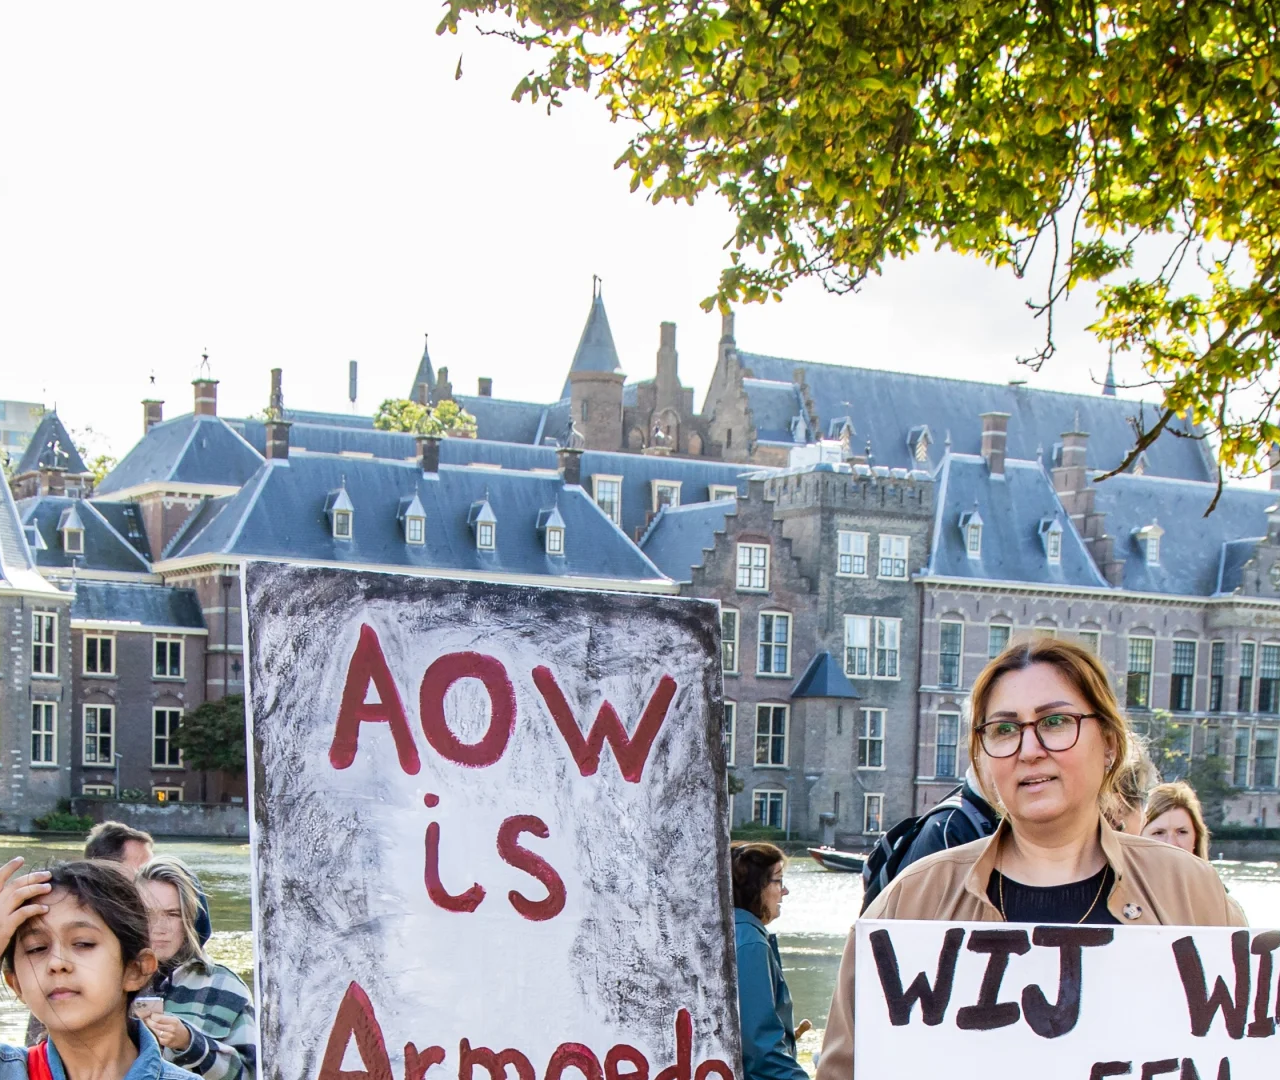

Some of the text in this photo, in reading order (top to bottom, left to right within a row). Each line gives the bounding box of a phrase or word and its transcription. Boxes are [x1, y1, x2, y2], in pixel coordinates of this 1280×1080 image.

[329, 622, 677, 783] AOW
[424, 793, 568, 921] is
[868, 927, 1114, 1039] WIJ
